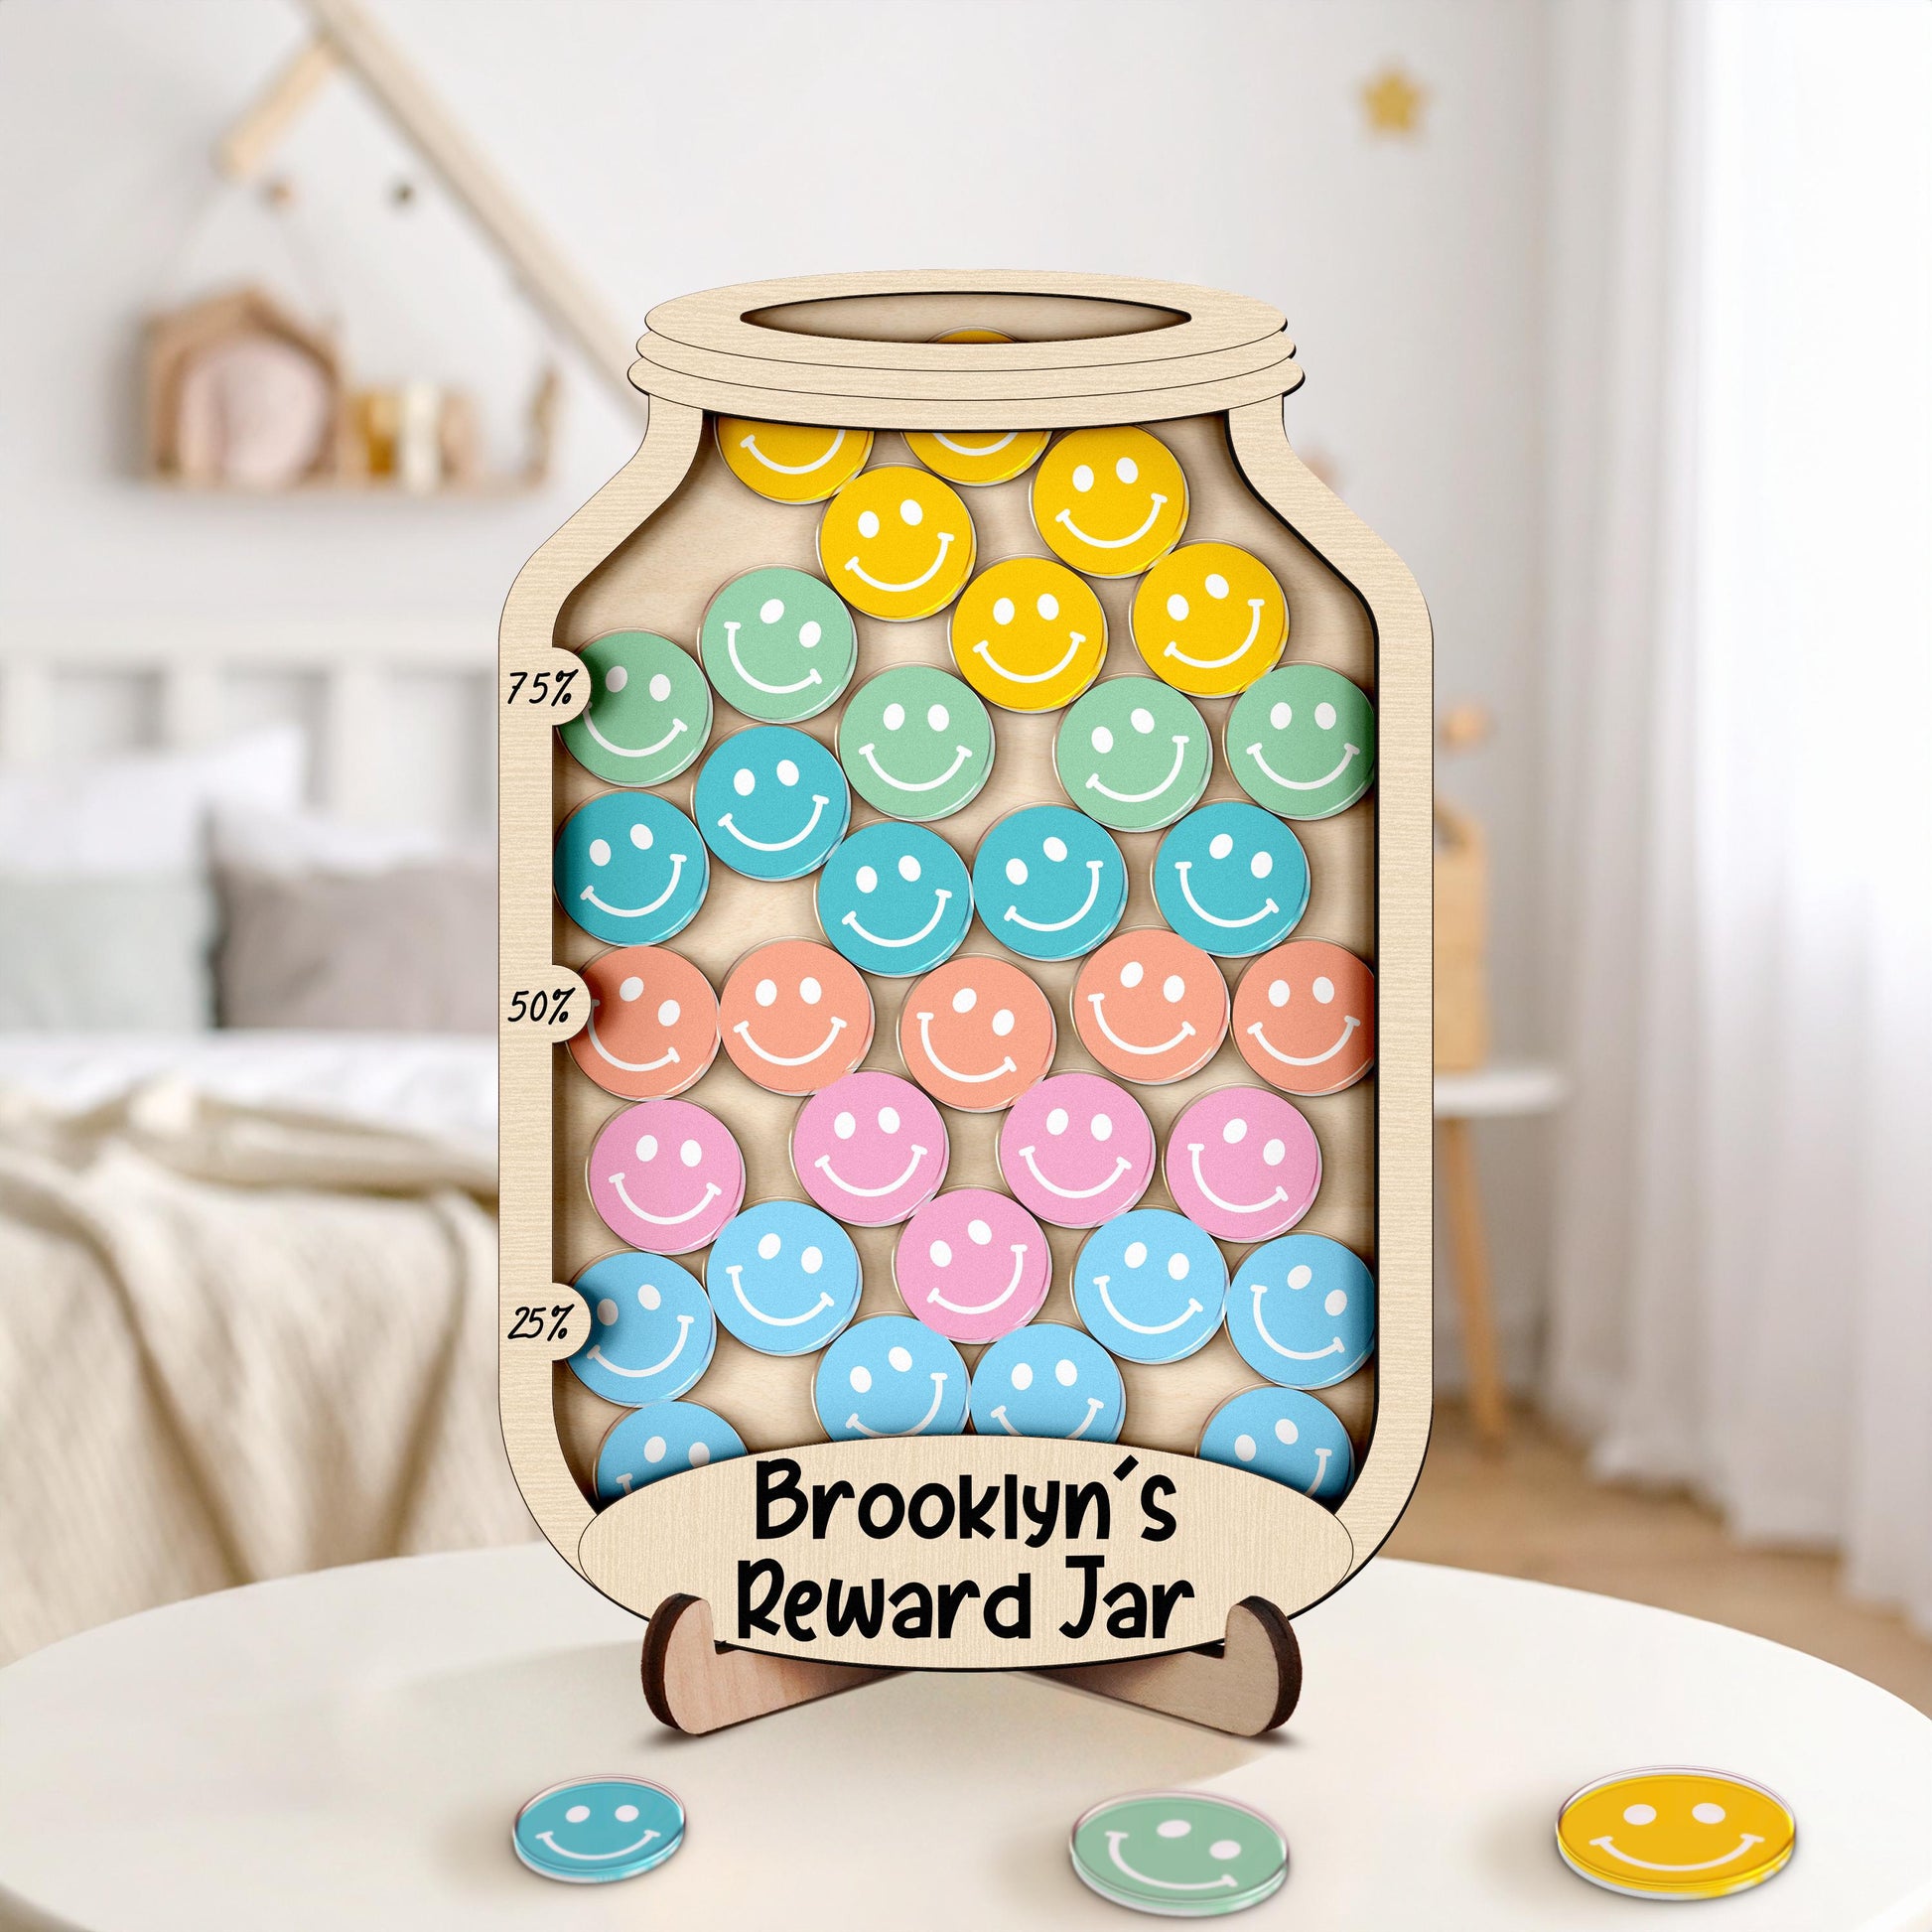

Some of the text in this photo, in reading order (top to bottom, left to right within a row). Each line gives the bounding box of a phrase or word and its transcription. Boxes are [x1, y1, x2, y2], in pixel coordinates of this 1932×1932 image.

[507, 668, 579, 707] 75%
[507, 987, 576, 1026] 50%
[506, 1303, 575, 1342] 25%
[756, 1453, 1177, 1549] Brooklyn's
[737, 1555, 1195, 1642] Reward Jar
